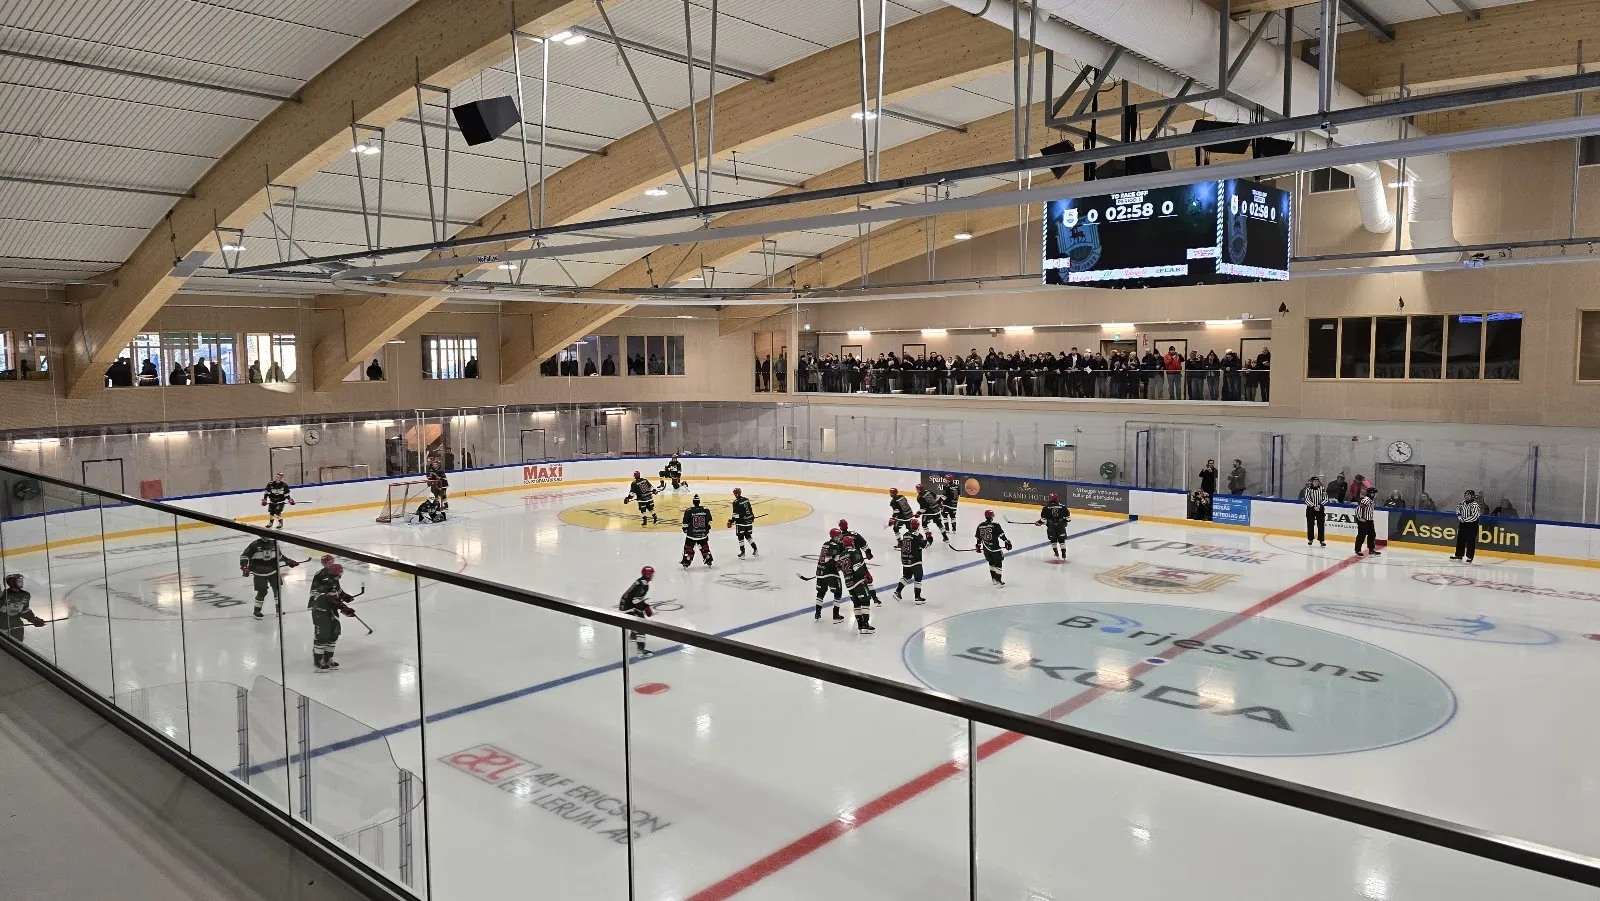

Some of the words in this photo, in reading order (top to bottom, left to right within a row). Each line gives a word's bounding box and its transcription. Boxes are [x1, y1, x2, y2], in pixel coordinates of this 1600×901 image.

[1087, 208, 1099, 223] 0
[1105, 202, 1154, 221] 02:58
[1161, 200, 1174, 215] 0
[1241, 200, 1248, 214] 0
[1249, 201, 1269, 219] 02:58
[1270, 206, 1276, 221] 0
[523, 465, 563, 480] MAXI
[1003, 491, 1027, 500] GRAND
[1402, 519, 1520, 547] Asseblin
